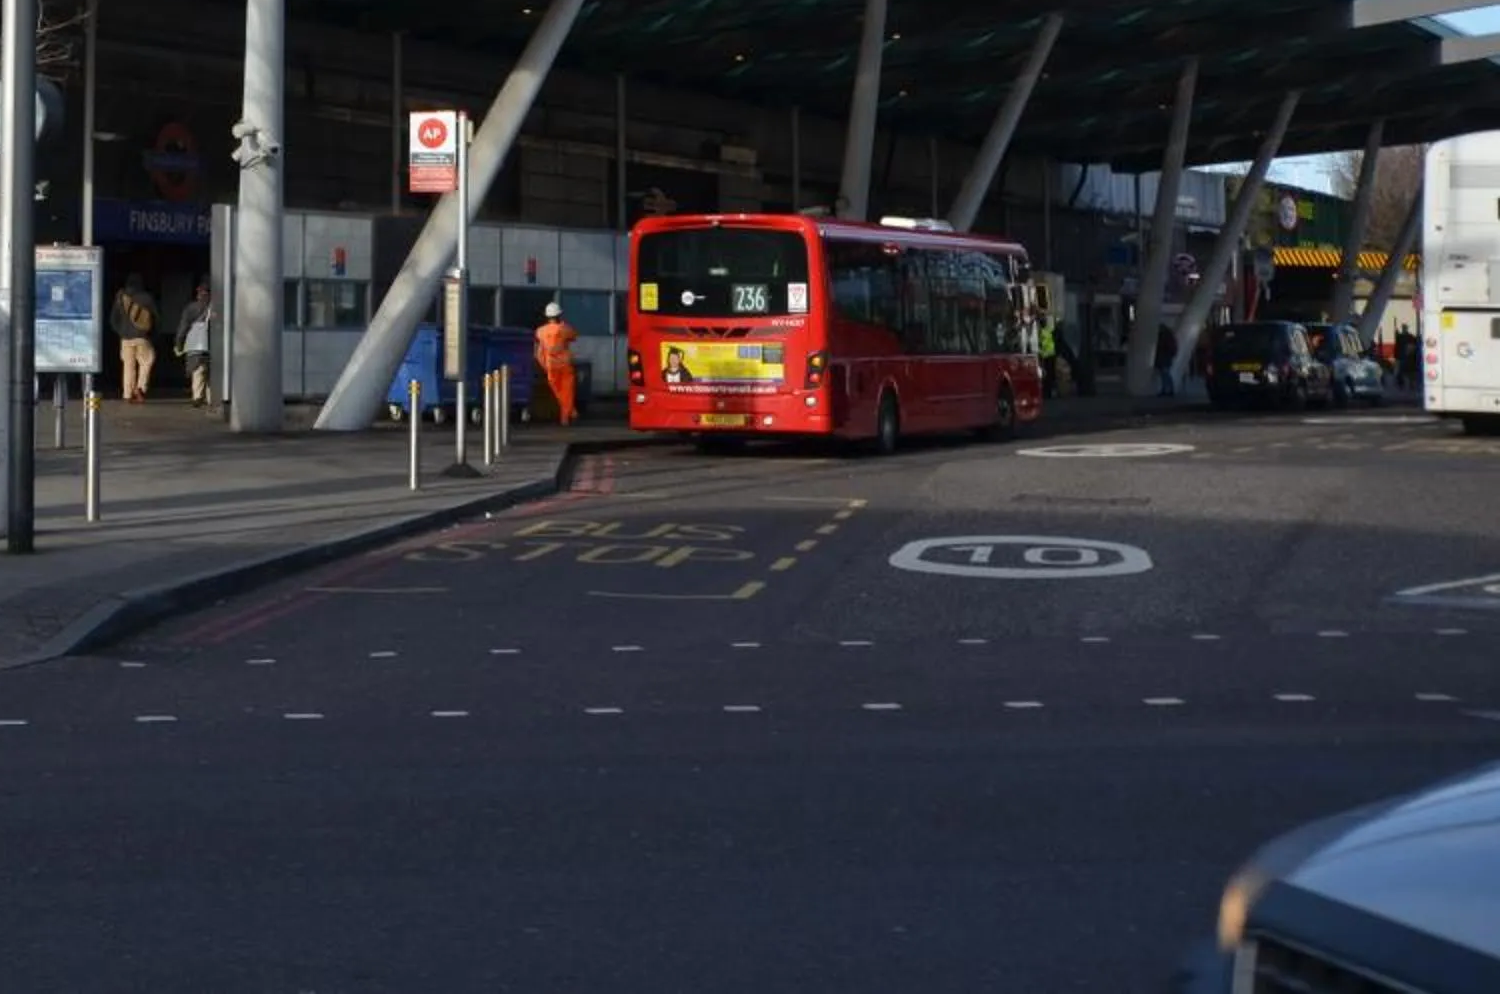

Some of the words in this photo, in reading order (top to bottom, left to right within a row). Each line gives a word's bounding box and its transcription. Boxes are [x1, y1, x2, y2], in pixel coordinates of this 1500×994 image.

[735, 286, 766, 311] 236
[513, 520, 748, 541] BUS
[403, 540, 756, 568] STOP
